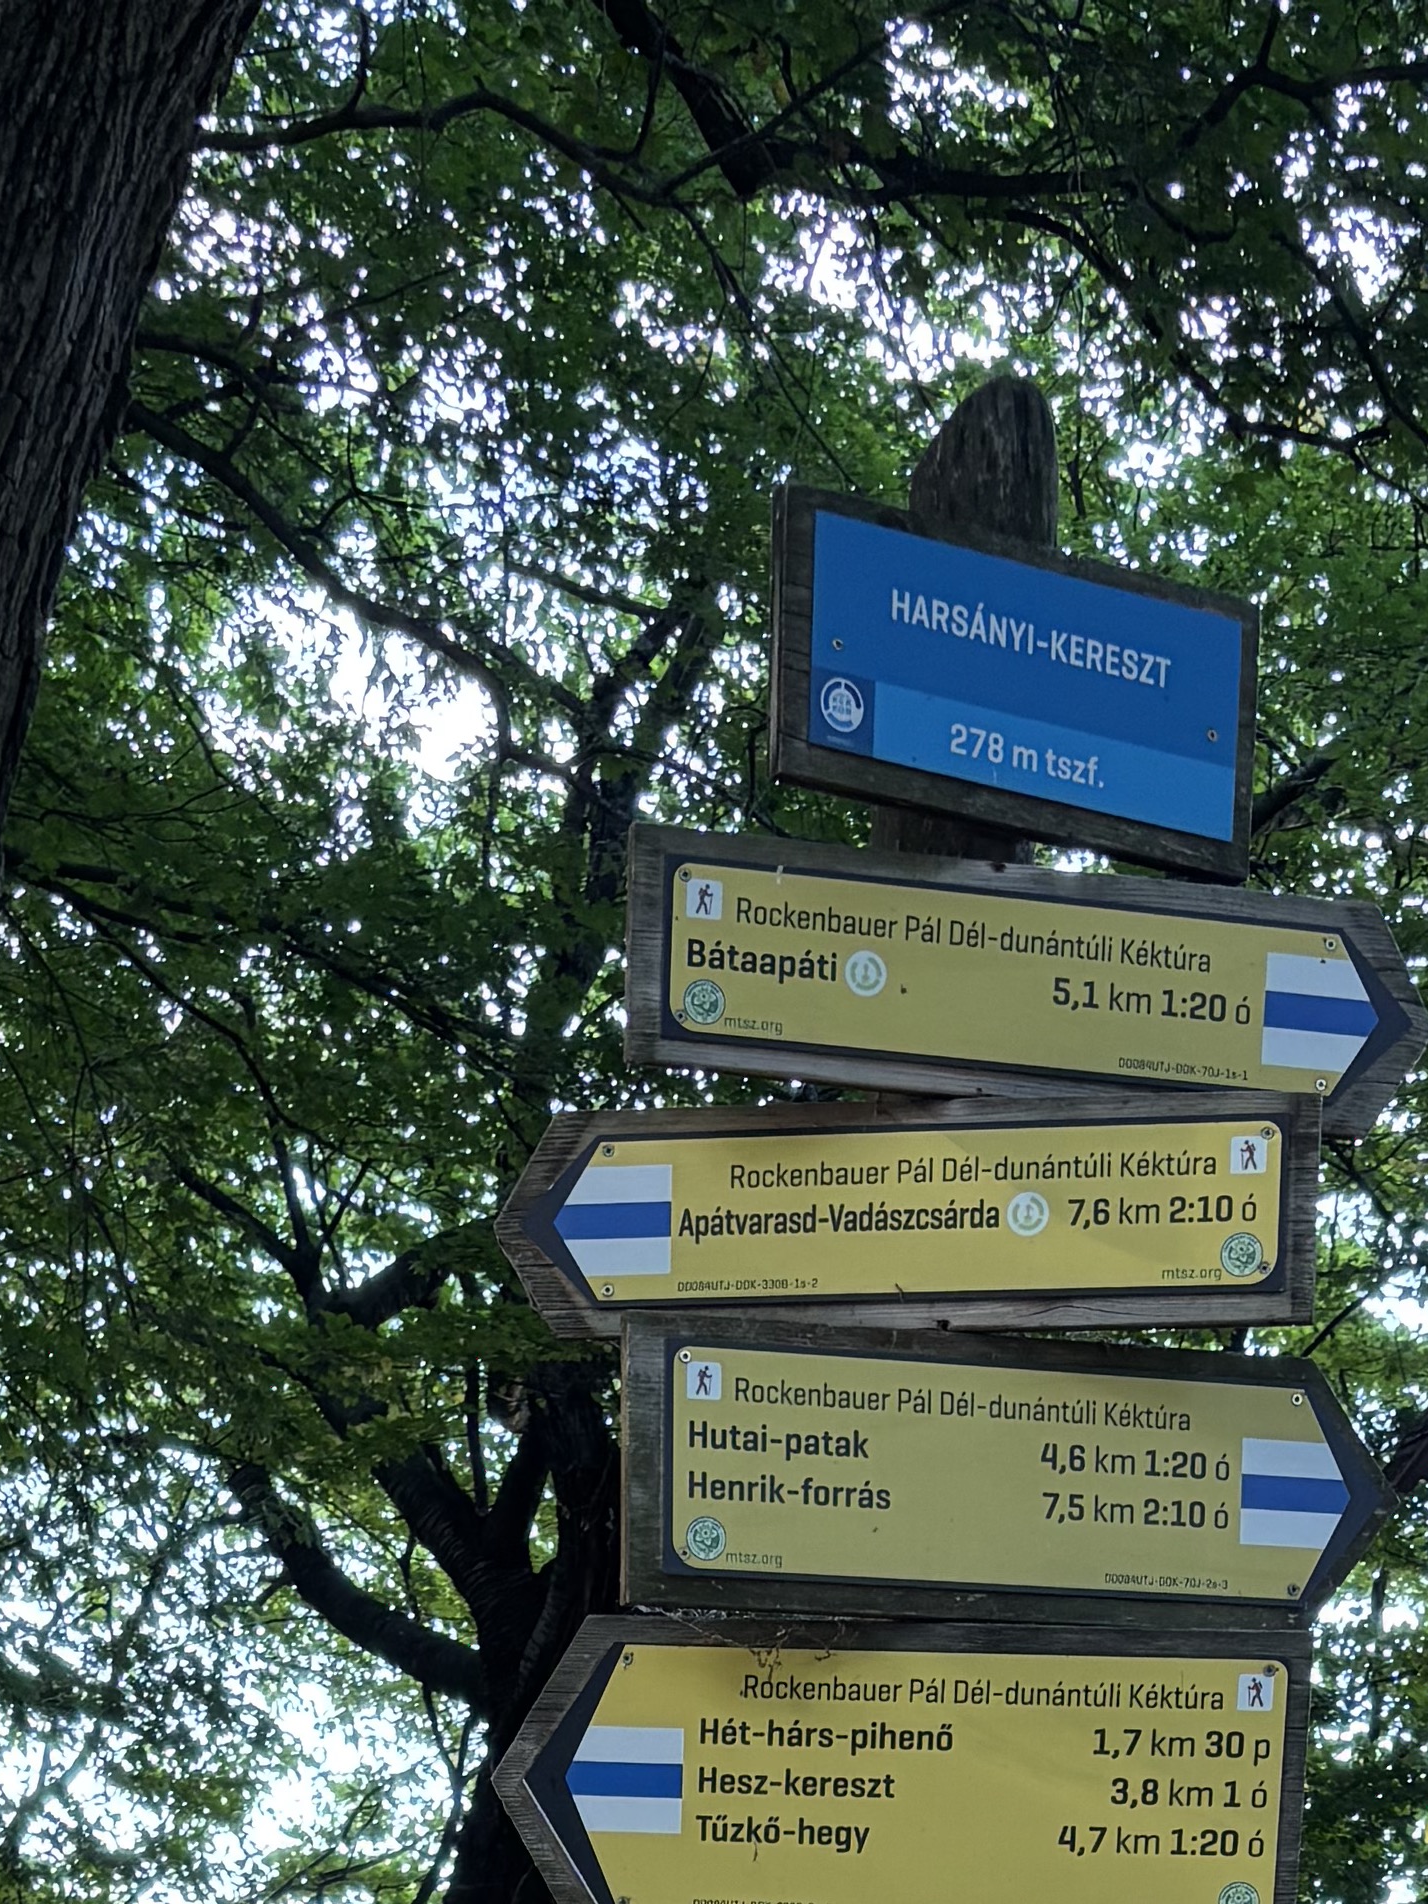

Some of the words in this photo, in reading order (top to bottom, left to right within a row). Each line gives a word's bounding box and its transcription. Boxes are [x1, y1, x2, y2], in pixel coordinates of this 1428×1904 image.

[890, 588, 1171, 689] HARSÁNYI-KERESZT
[950, 724, 1004, 763] 278
[1012, 746, 1037, 772] m
[1046, 749, 1105, 788] tszf.
[736, 897, 898, 939] Rockenbauer
[905, 915, 941, 943] Pál
[949, 919, 1113, 962] Dél-dunántúli
[1121, 937, 1211, 973] Kéktúra
[687, 939, 838, 984] Bátaapáti
[1052, 977, 1099, 1011] 5,1
[1109, 983, 1151, 1015] km
[1161, 990, 1226, 1022] 1:20
[1236, 996, 1251, 1025] ó
[724, 1016, 783, 1036] mtsz.org
[730, 1161, 890, 1189] Rockenbauer
[897, 1157, 933, 1183] Pál
[943, 1152, 1112, 1182] Dél-dunántúli
[1121, 1149, 1217, 1177] Kéktúra
[678, 1199, 999, 1244] Apátvarasd-Vadászcsárda
[1068, 1198, 1110, 1230] 7,6
[1119, 1197, 1160, 1225] km
[1169, 1195, 1233, 1223] 2:10
[1242, 1193, 1257, 1221] ó
[1162, 1267, 1222, 1281] mtsz.org
[734, 1377, 891, 1411] Rockenbauer
[897, 1388, 932, 1415] Pál
[940, 1391, 1097, 1427] Dél-dunántúli
[1104, 1401, 1191, 1431] Kéktúra
[689, 1420, 869, 1461] Hutai-patak
[1040, 1442, 1086, 1475] 4,6
[1095, 1446, 1136, 1475] km
[1144, 1450, 1207, 1479] 1:20
[1215, 1454, 1230, 1481] ó
[688, 1470, 891, 1510] Henrik-forrás
[1042, 1492, 1085, 1525] 7,5
[1094, 1494, 1135, 1524] km
[1143, 1499, 1206, 1529] 2:10
[1214, 1502, 1229, 1530] ó
[725, 1551, 783, 1568] mtsz.org
[743, 1675, 902, 1703] Rockenbauer
[909, 1678, 945, 1704] Pál
[954, 1679, 1121, 1708] Dél-dunántúli
[1129, 1683, 1224, 1711] Kéktúra
[699, 1718, 953, 1756] Hét-hárs-pihenő
[1092, 1728, 1142, 1759] 1,7
[1151, 1728, 1195, 1757] km
[1204, 1730, 1245, 1759] 30
[1253, 1738, 1271, 1766] p
[698, 1766, 896, 1799] Hesz-kereszt
[1110, 1777, 1159, 1810] 3,8
[1168, 1778, 1213, 1807] km
[1223, 1781, 1241, 1808] 1
[1251, 1780, 1267, 1809] ó
[695, 1815, 870, 1854] Tűzkő-hegy
[1058, 1825, 1107, 1857] 4,7
[1115, 1827, 1160, 1855] km
[1170, 1829, 1239, 1856] 1:20
[1248, 1829, 1265, 1858] ó
